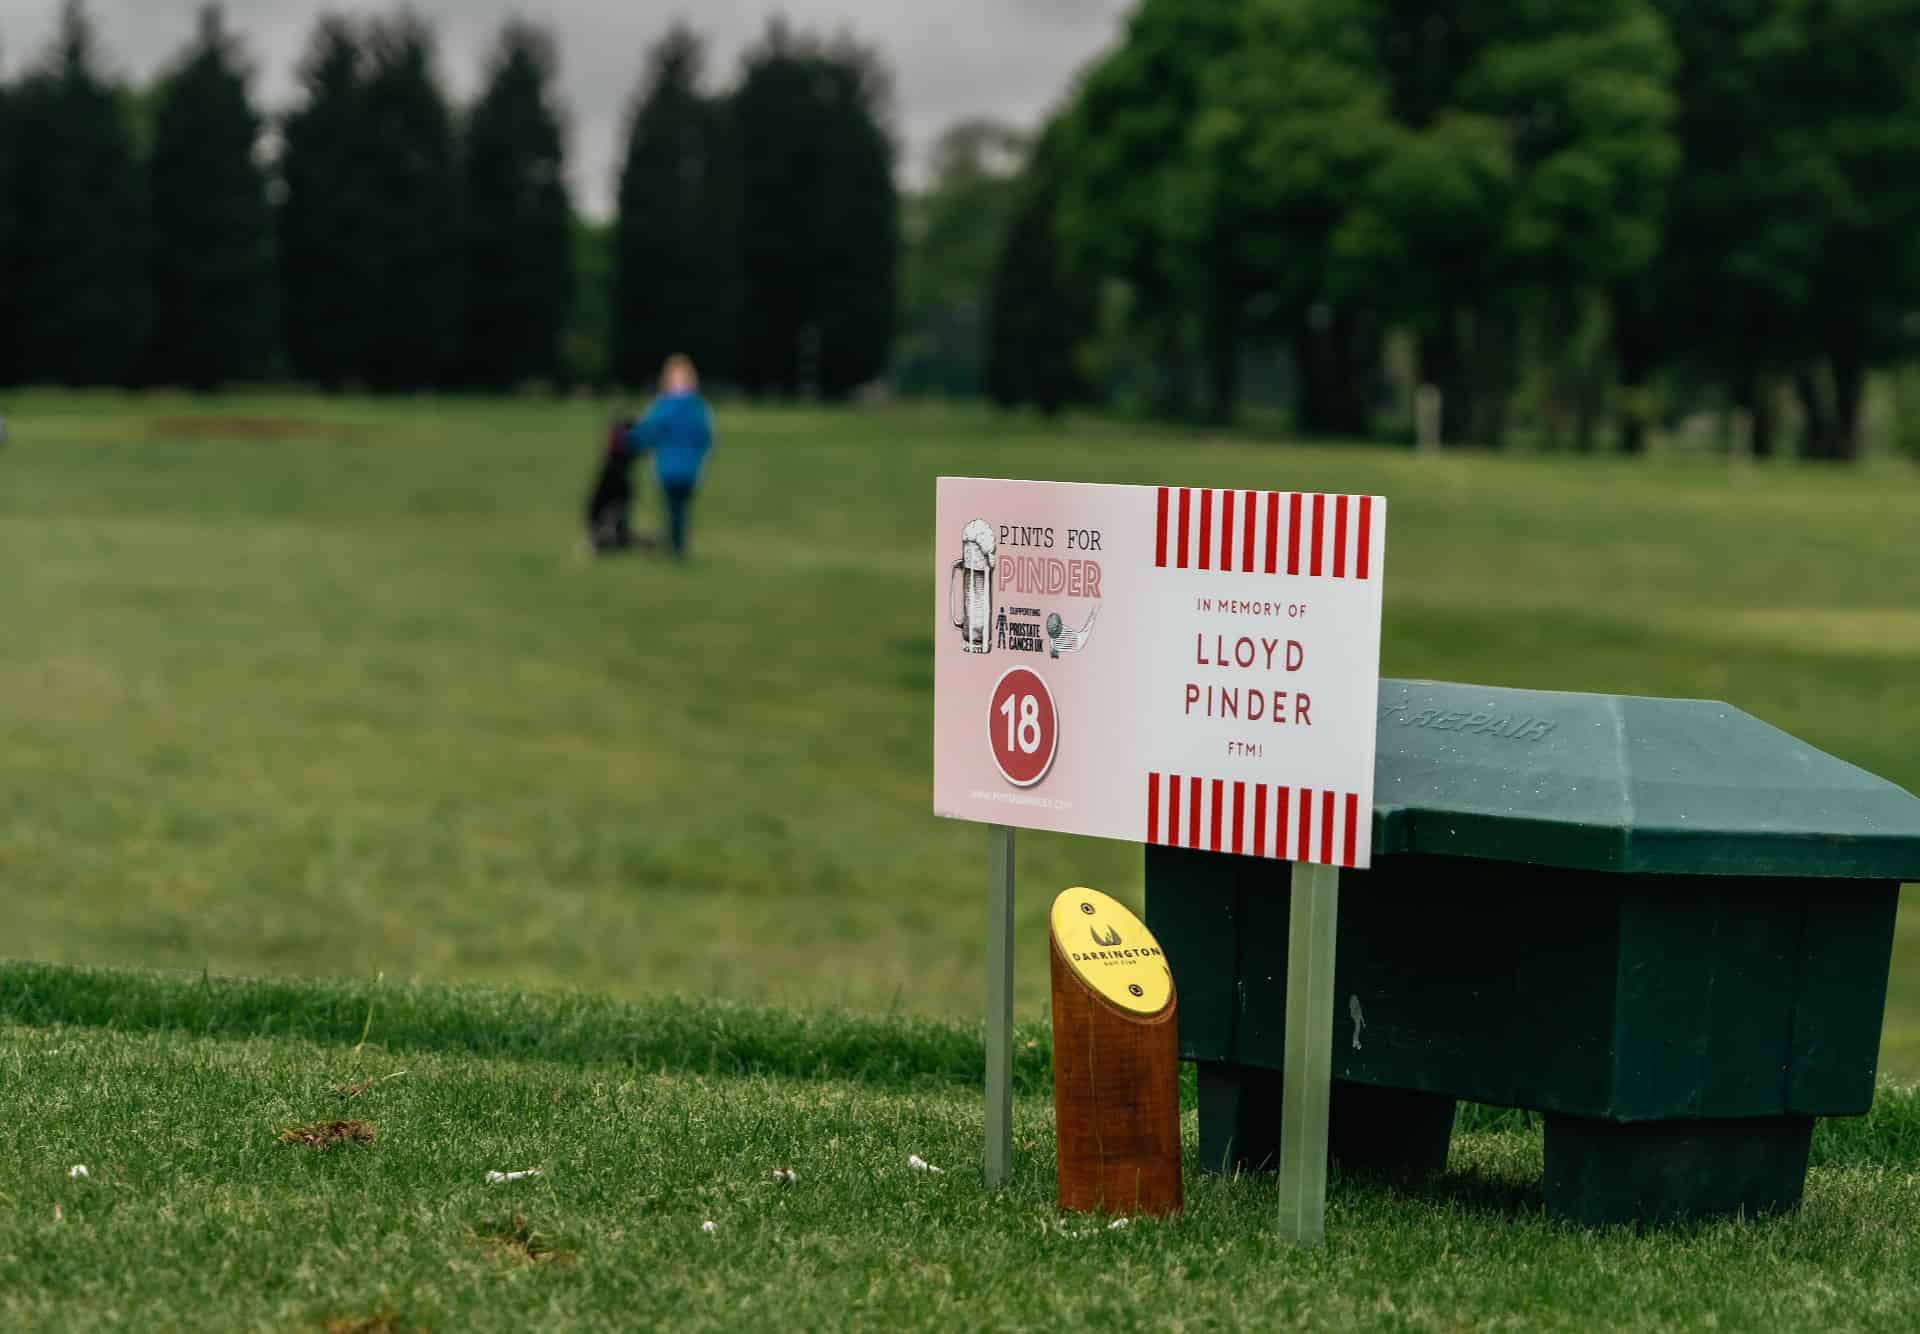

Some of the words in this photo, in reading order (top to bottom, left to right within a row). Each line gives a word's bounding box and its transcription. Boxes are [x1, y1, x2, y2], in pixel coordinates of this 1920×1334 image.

[1000, 525, 1055, 548] PINTS
[1067, 529, 1103, 550] FOR
[998, 555, 1102, 598] PINDER
[1197, 598, 1212, 611] IN
[1218, 600, 1281, 616] MEMORY
[1288, 604, 1307, 618] OF
[1009, 622, 1041, 638] PROSTATE
[1009, 636, 1034, 651] CANCER
[1197, 633, 1304, 672] LLOYD
[1185, 683, 1312, 726] PINDER
[1000, 693, 1041, 754] 18
[1400, 707, 1560, 742] REPAIR
[1072, 947, 1161, 962] DARRINGTON
